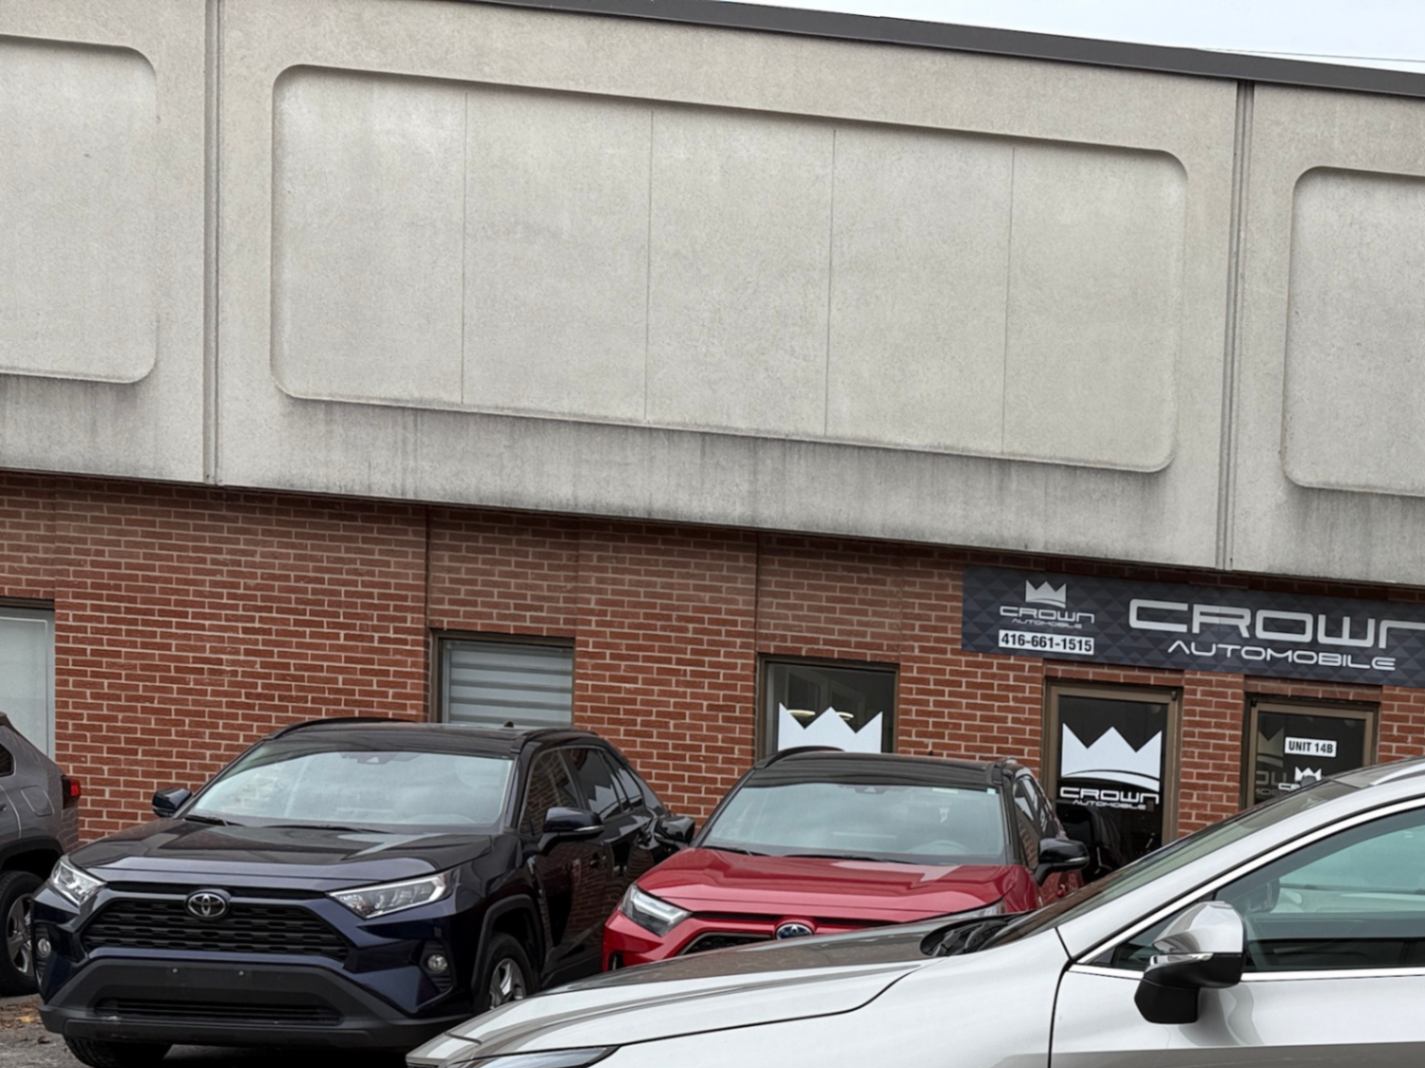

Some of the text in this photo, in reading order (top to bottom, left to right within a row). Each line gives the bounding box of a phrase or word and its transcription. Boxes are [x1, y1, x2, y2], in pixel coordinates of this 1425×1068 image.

[999, 606, 1095, 624] CROWN
[1011, 618, 1082, 629] AUTOMOBILE
[1001, 633, 1093, 653] 416-661-1515
[1168, 640, 1397, 671] AUTOMOBILE
[1288, 741, 1334, 754] UNIT 14B
[1060, 786, 1160, 805] CROWN
[1072, 799, 1147, 810] AUTOMOBILE
